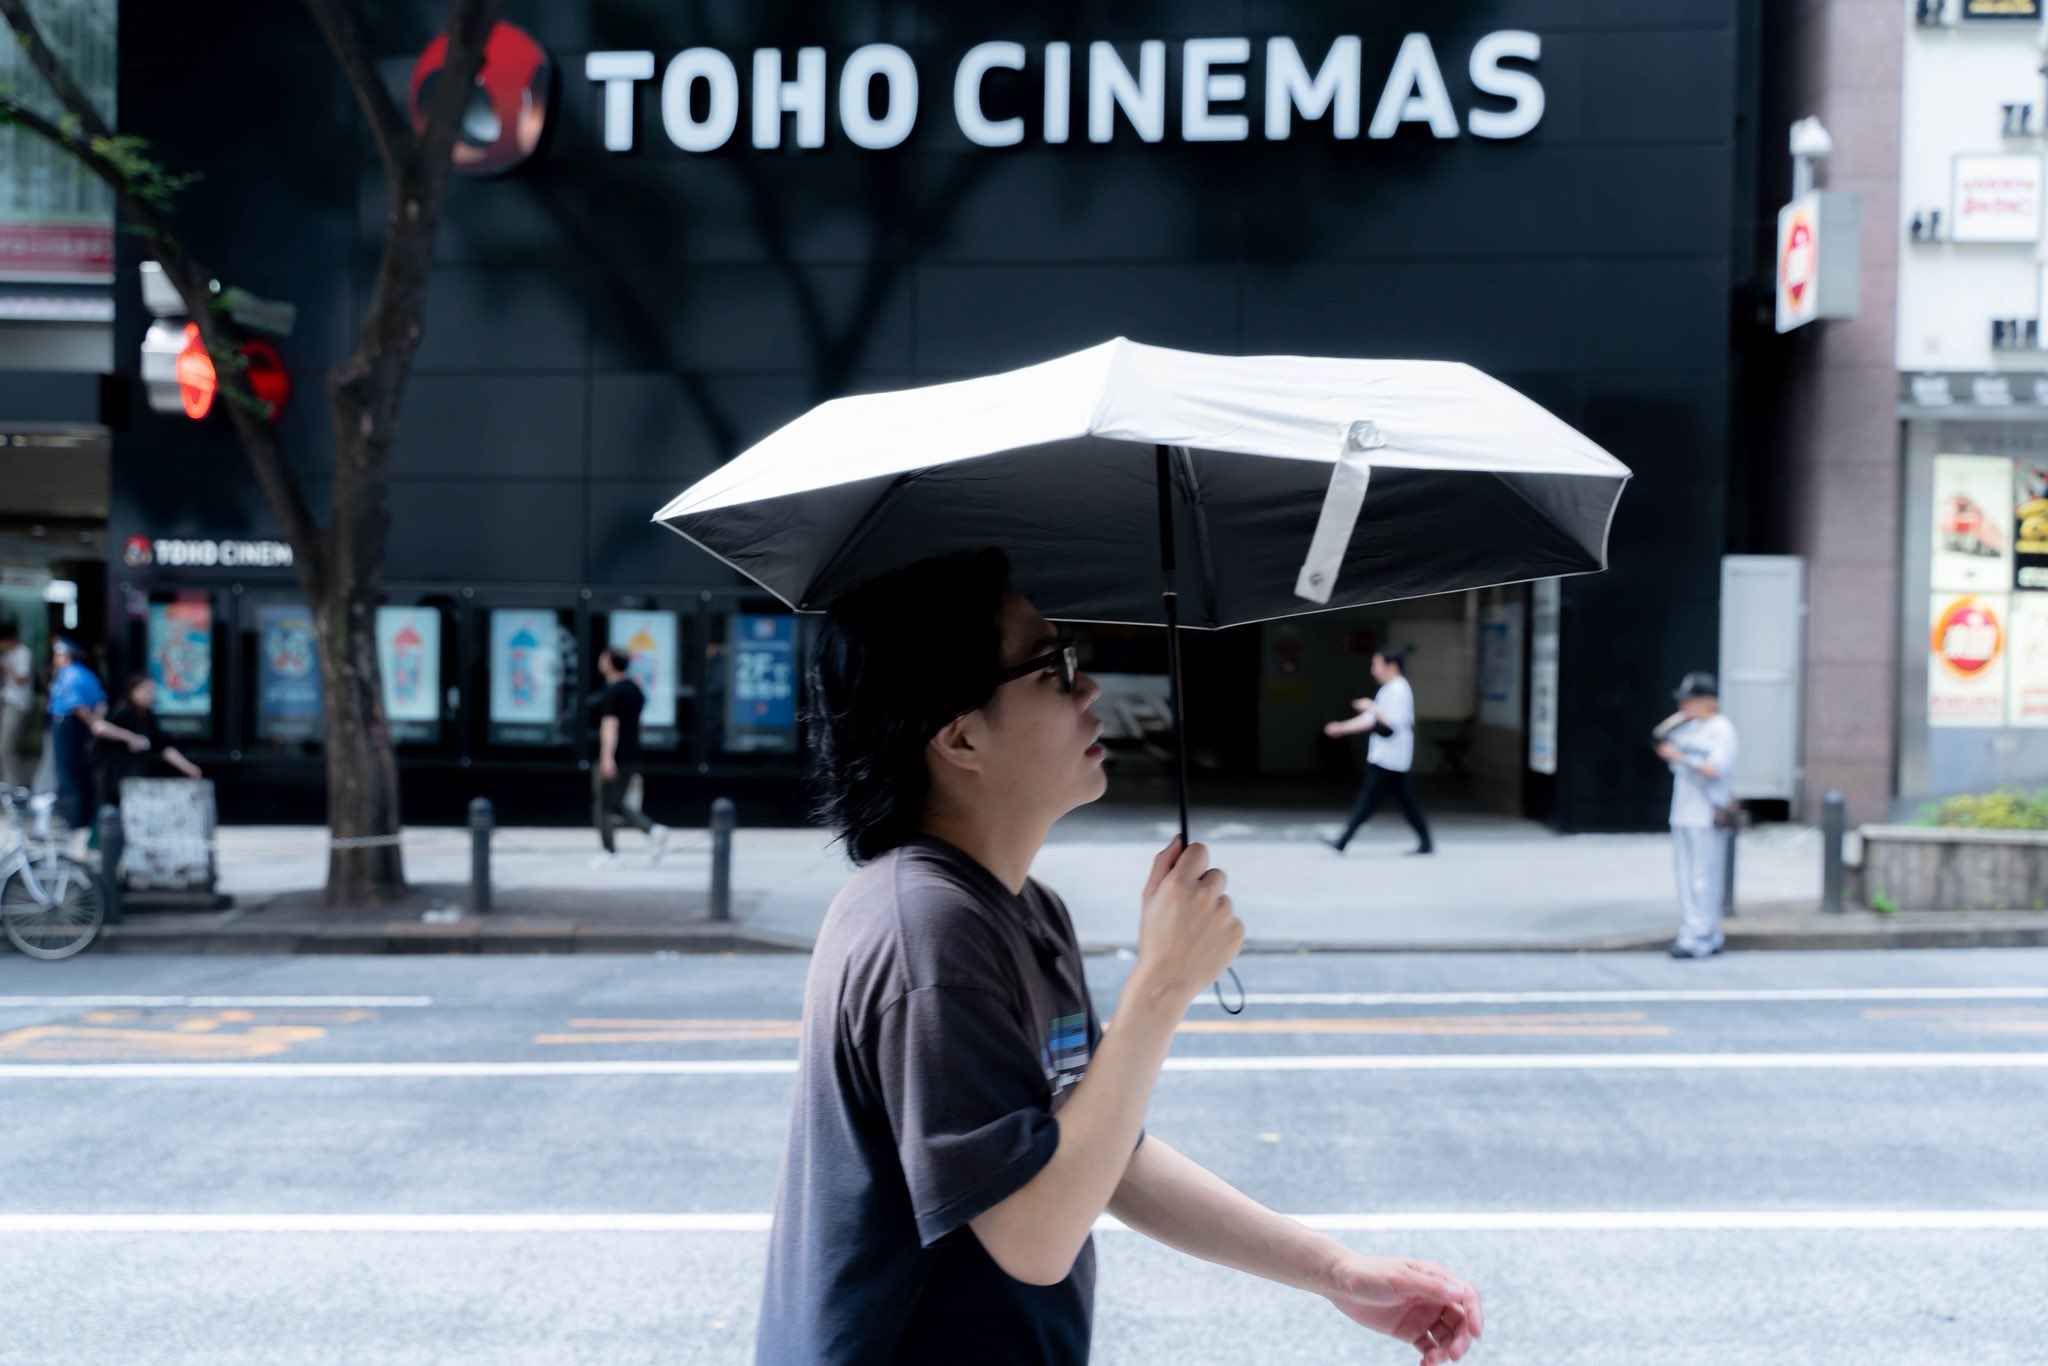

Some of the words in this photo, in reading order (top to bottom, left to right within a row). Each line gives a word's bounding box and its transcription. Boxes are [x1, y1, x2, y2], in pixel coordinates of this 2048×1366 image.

[584, 42, 919, 151] TOHO
[952, 29, 1546, 147] CINEMAS
[153, 539, 218, 566] TOHO
[219, 540, 294, 567] CINEM
